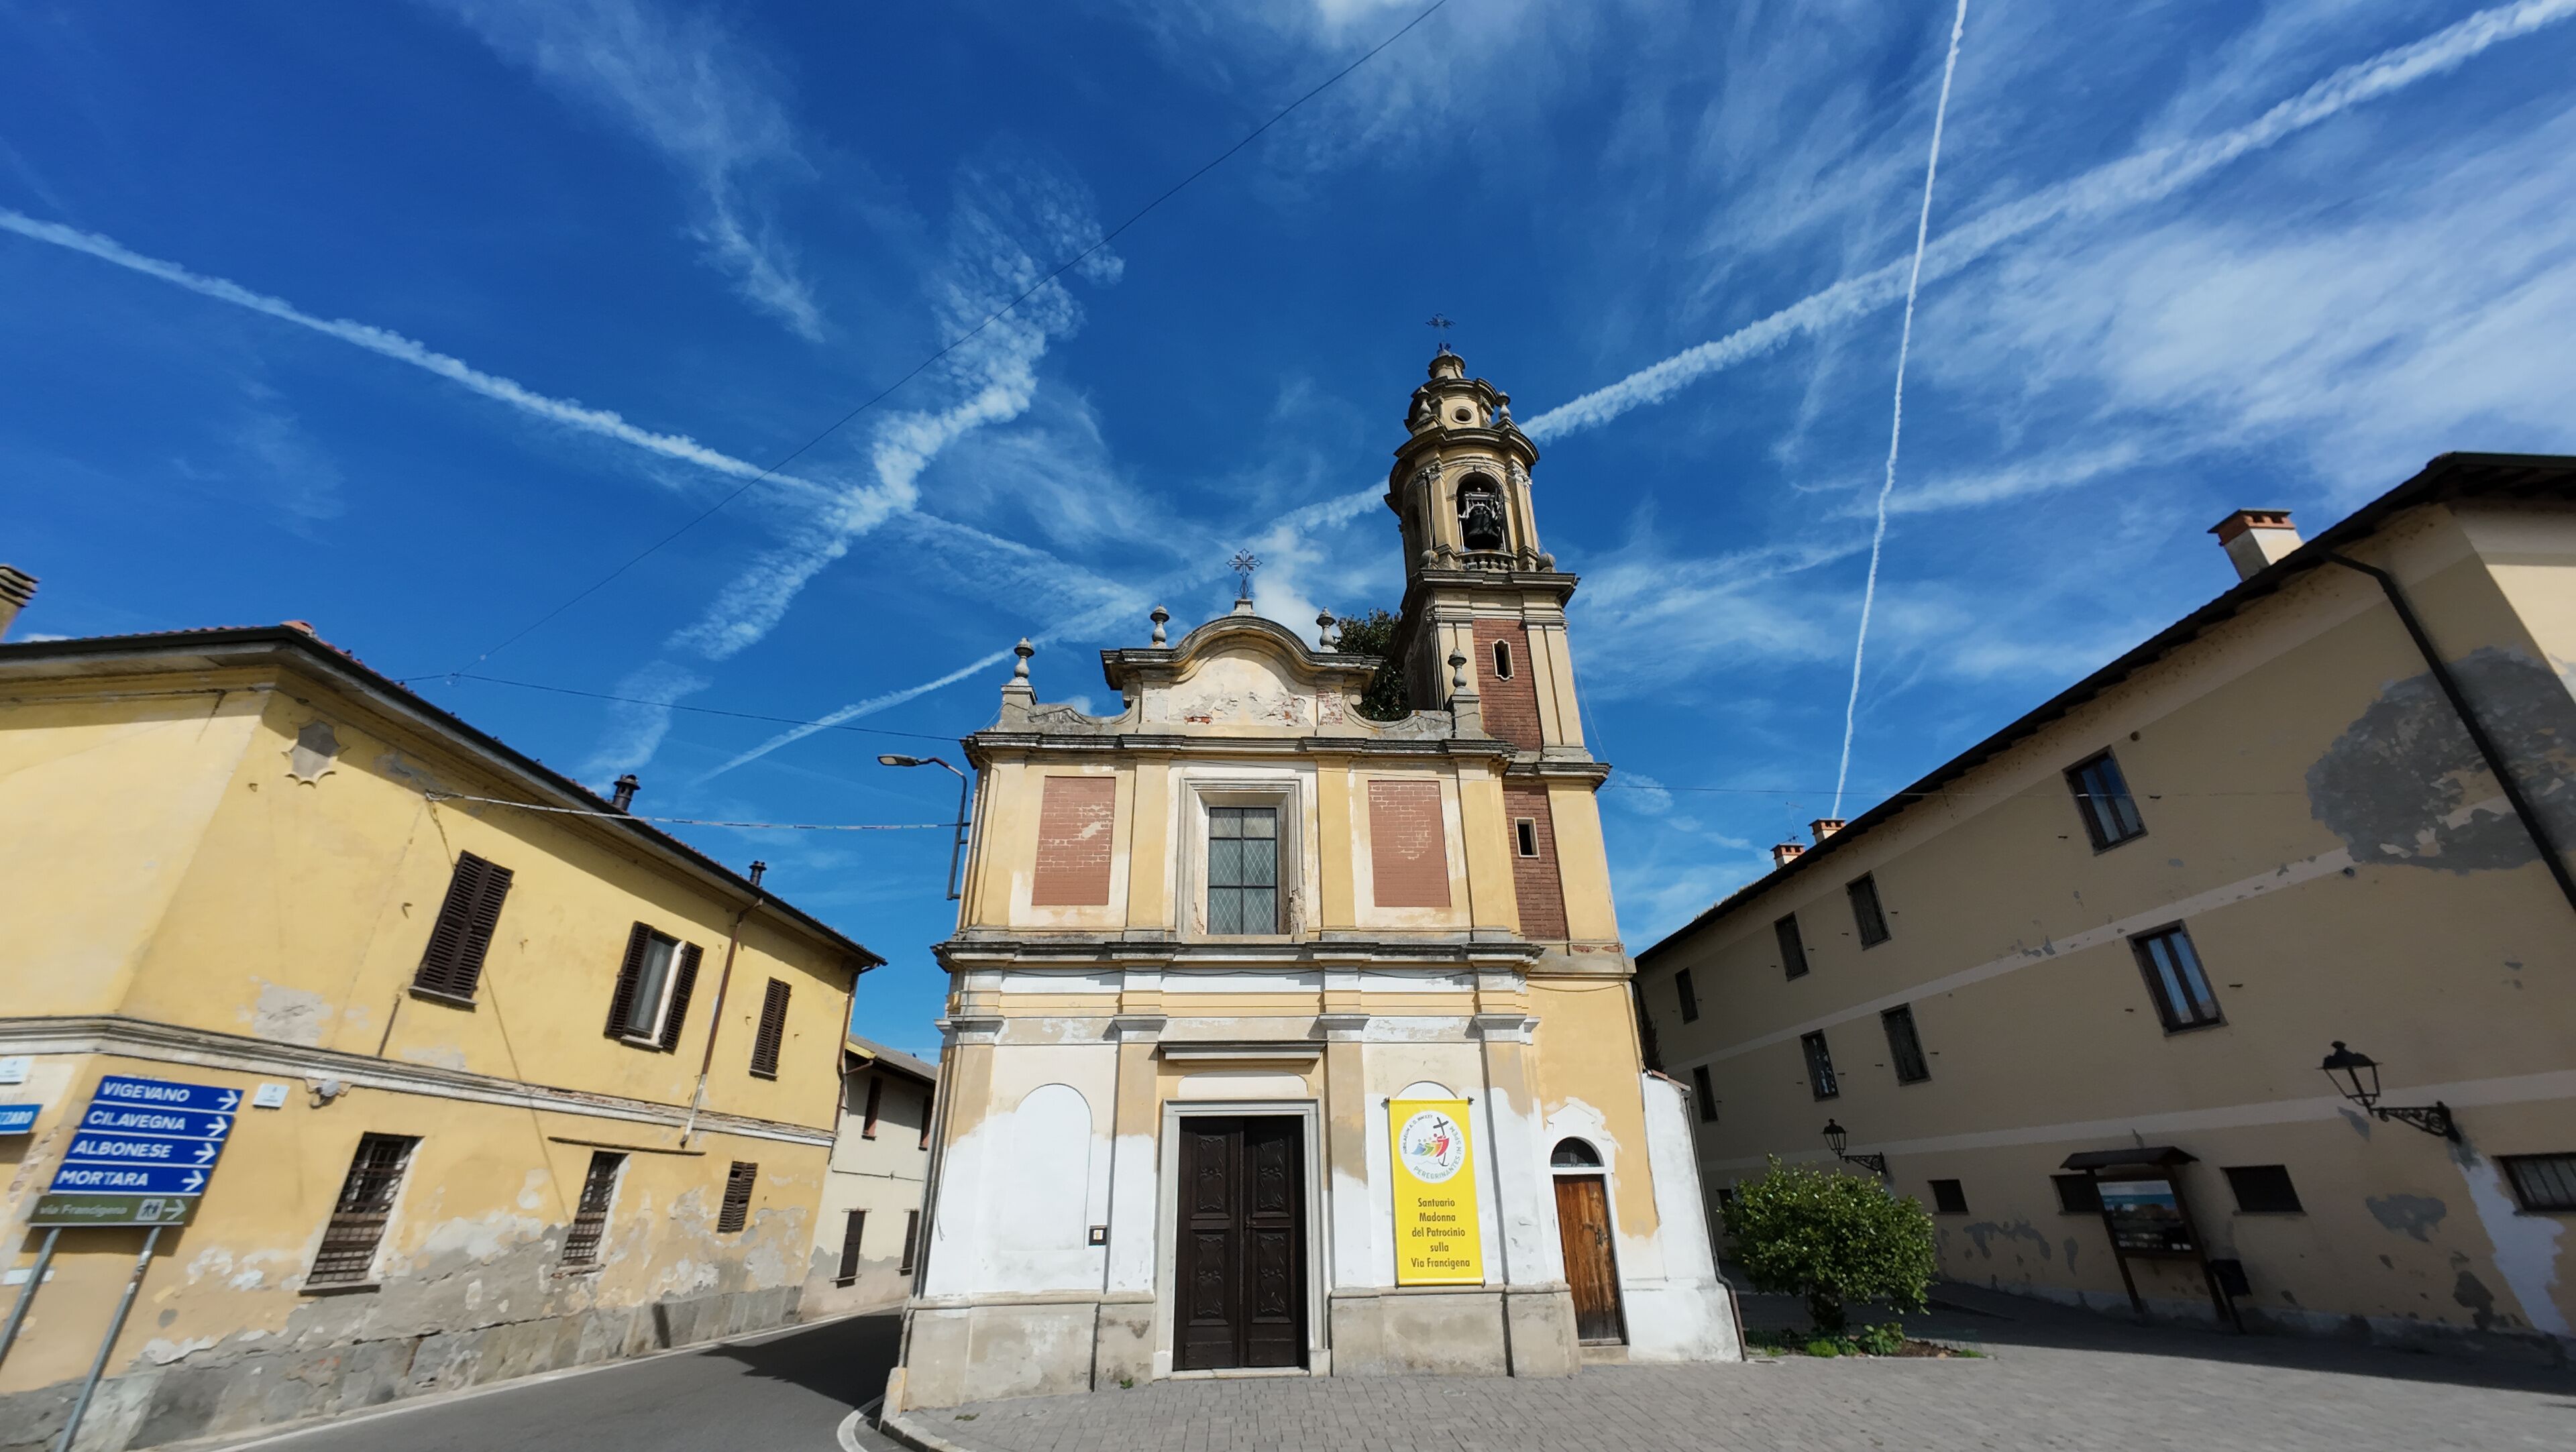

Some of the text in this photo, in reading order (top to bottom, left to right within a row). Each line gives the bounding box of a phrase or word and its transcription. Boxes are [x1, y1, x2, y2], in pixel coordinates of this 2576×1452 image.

[103, 1082, 190, 1102] VIGEVANO
[89, 1111, 185, 1131] CILAVEGNA
[72, 1140, 173, 1158] ALBONESE
[1413, 1156, 1460, 1179] PEREGRINANTES
[1450, 1126, 1461, 1145] SPEM
[57, 1170, 149, 1186] MORTARA
[1417, 1198, 1455, 1207] Santuario
[1419, 1212, 1456, 1221] Madonna
[1412, 1227, 1465, 1237] del Patrocinio
[1430, 1241, 1449, 1251] sulla
[1411, 1258, 1470, 1270] Via Francigena
